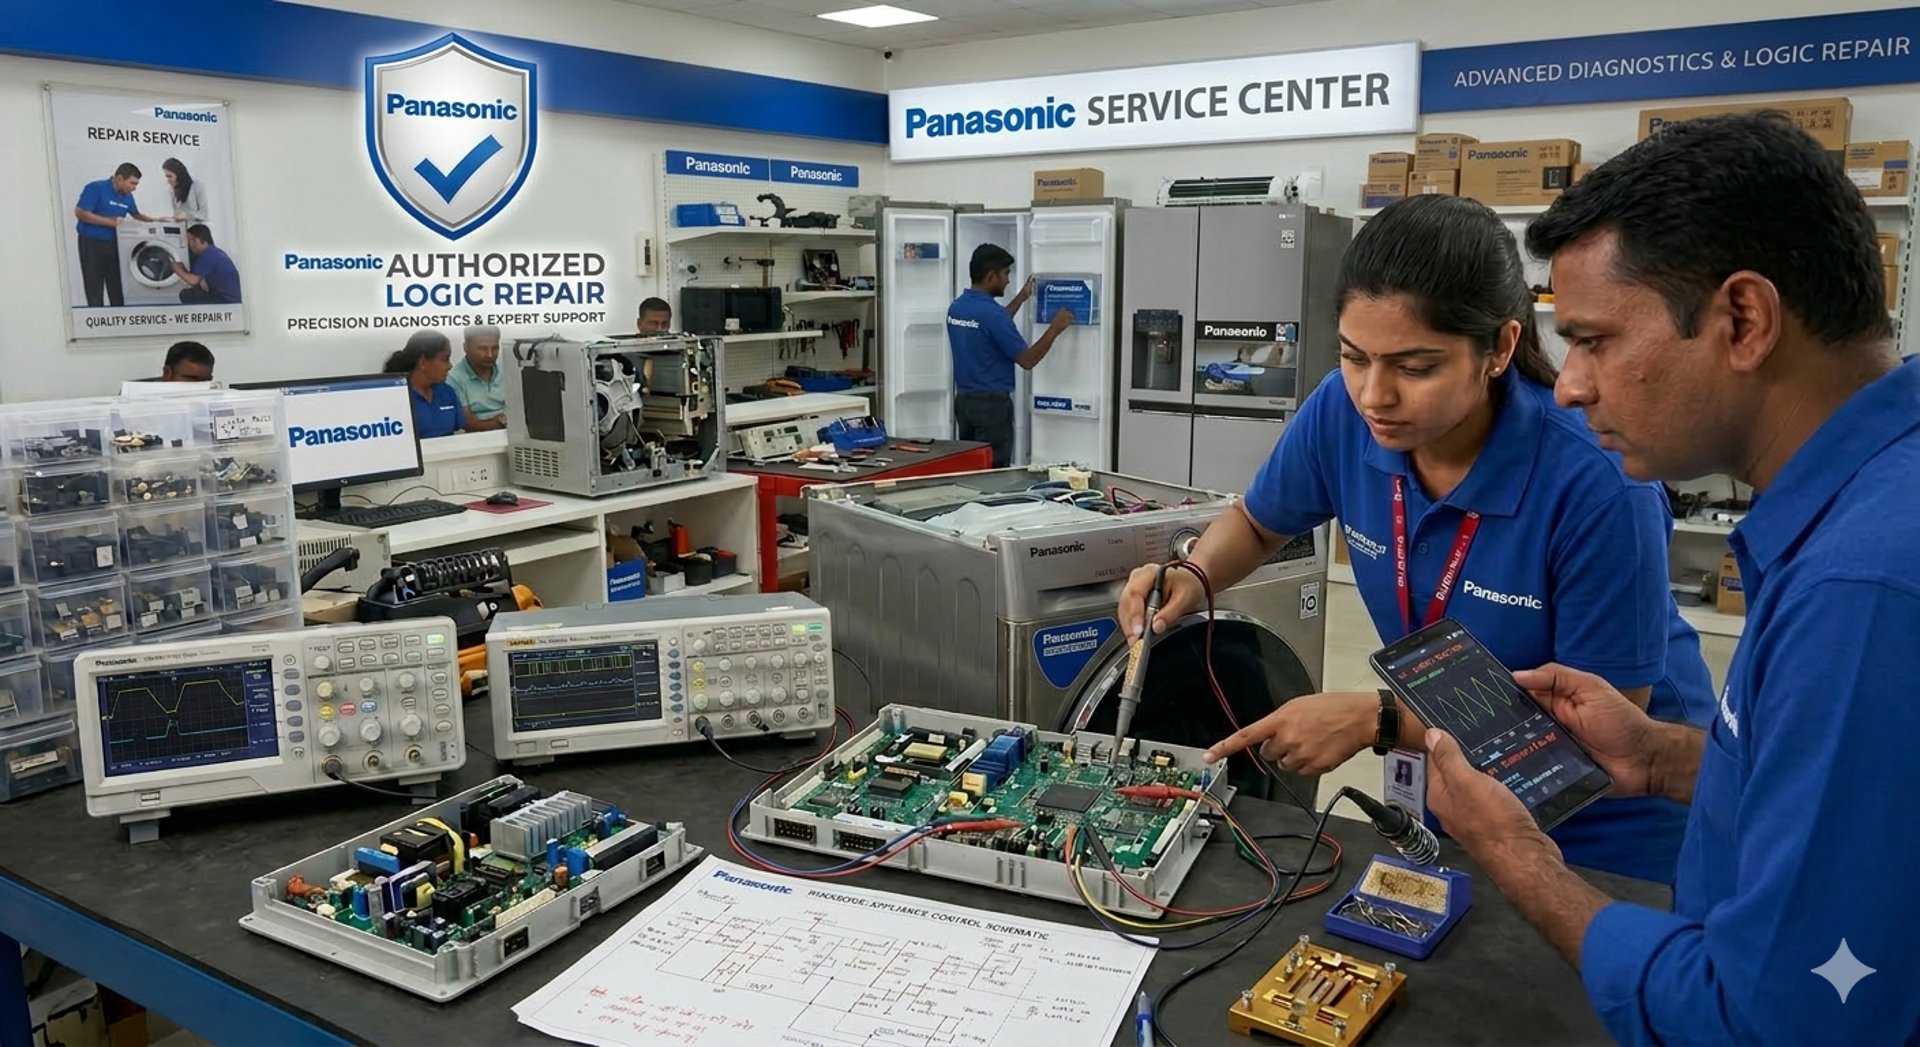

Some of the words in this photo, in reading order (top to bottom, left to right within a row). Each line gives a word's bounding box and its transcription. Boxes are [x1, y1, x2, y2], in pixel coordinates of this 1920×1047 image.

[1454, 64, 1562, 88] ADVANCED
[1568, 51, 1713, 79] DIAGNOSTICS
[1720, 50, 1737, 68] &
[1743, 44, 1815, 67] LOGIC
[1821, 36, 1911, 61] REPAIR
[905, 96, 1076, 138] Panasonic
[1087, 85, 1229, 126] SERVICE
[1238, 72, 1390, 114] CENTER
[154, 107, 218, 123] Panasonic
[88, 127, 140, 143] REPAIR
[143, 131, 200, 146] SERVICE
[686, 156, 751, 175] Panasonic
[129, 314, 167, 326] SERVICE
[174, 313, 189, 324] WE
[191, 312, 223, 323] REPAIR
[288, 416, 404, 448] Panasonic
[1030, 541, 1085, 558] Panasonic
